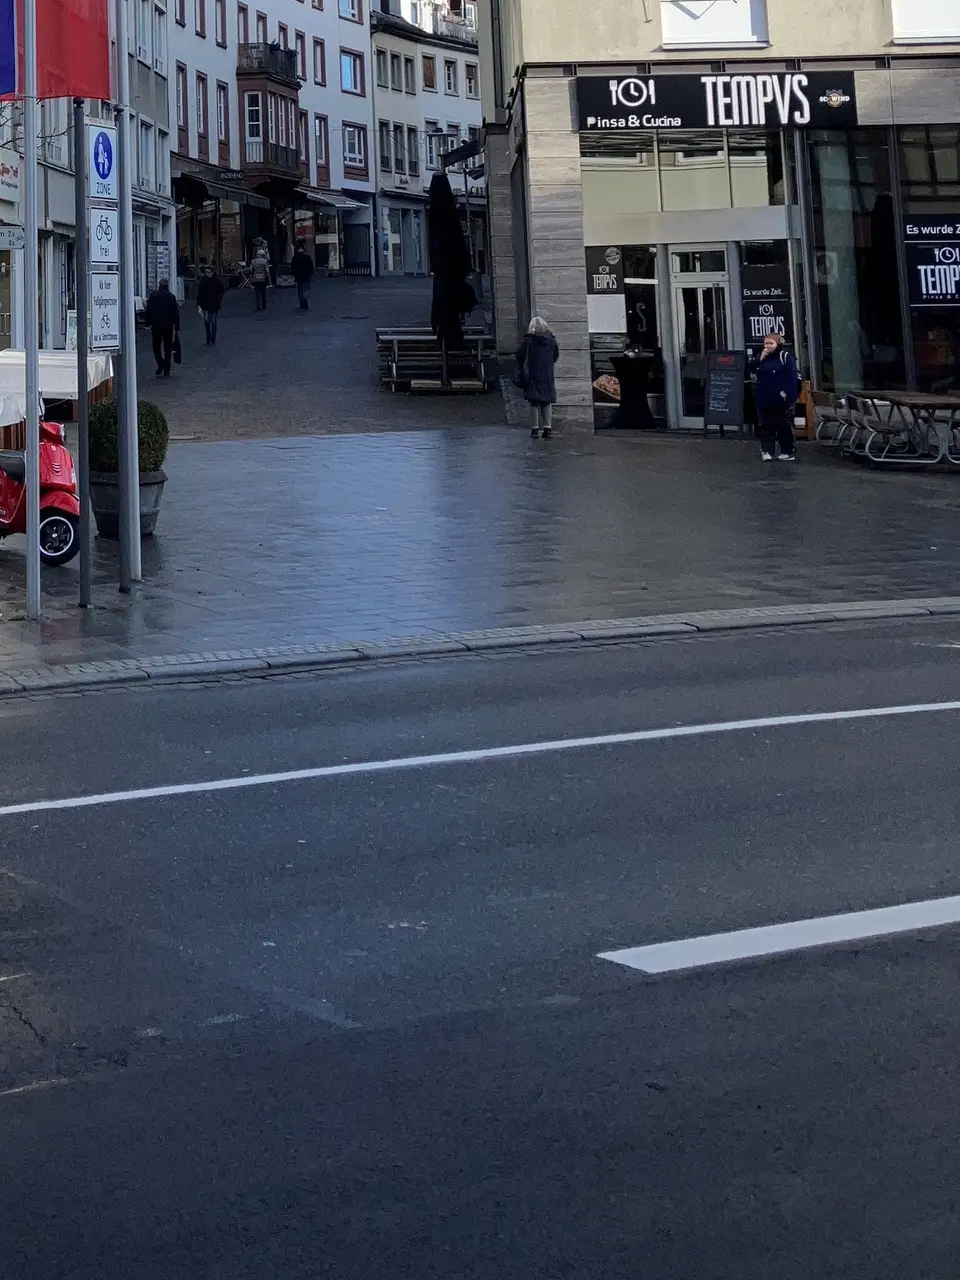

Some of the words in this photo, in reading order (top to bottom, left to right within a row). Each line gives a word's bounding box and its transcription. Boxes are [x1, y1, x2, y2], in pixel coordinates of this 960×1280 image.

[700, 74, 811, 126] TEMPVS
[586, 116, 626, 128] Pinsa
[628, 114, 640, 127] &
[642, 113, 682, 127] Cucina
[96, 182, 111, 195] ZONE
[906, 224, 919, 234] Es
[921, 224, 954, 234] wurde
[592, 274, 617, 289] TEMPVS
[917, 265, 960, 294] TEMP
[749, 316, 786, 337] TEMPVS
